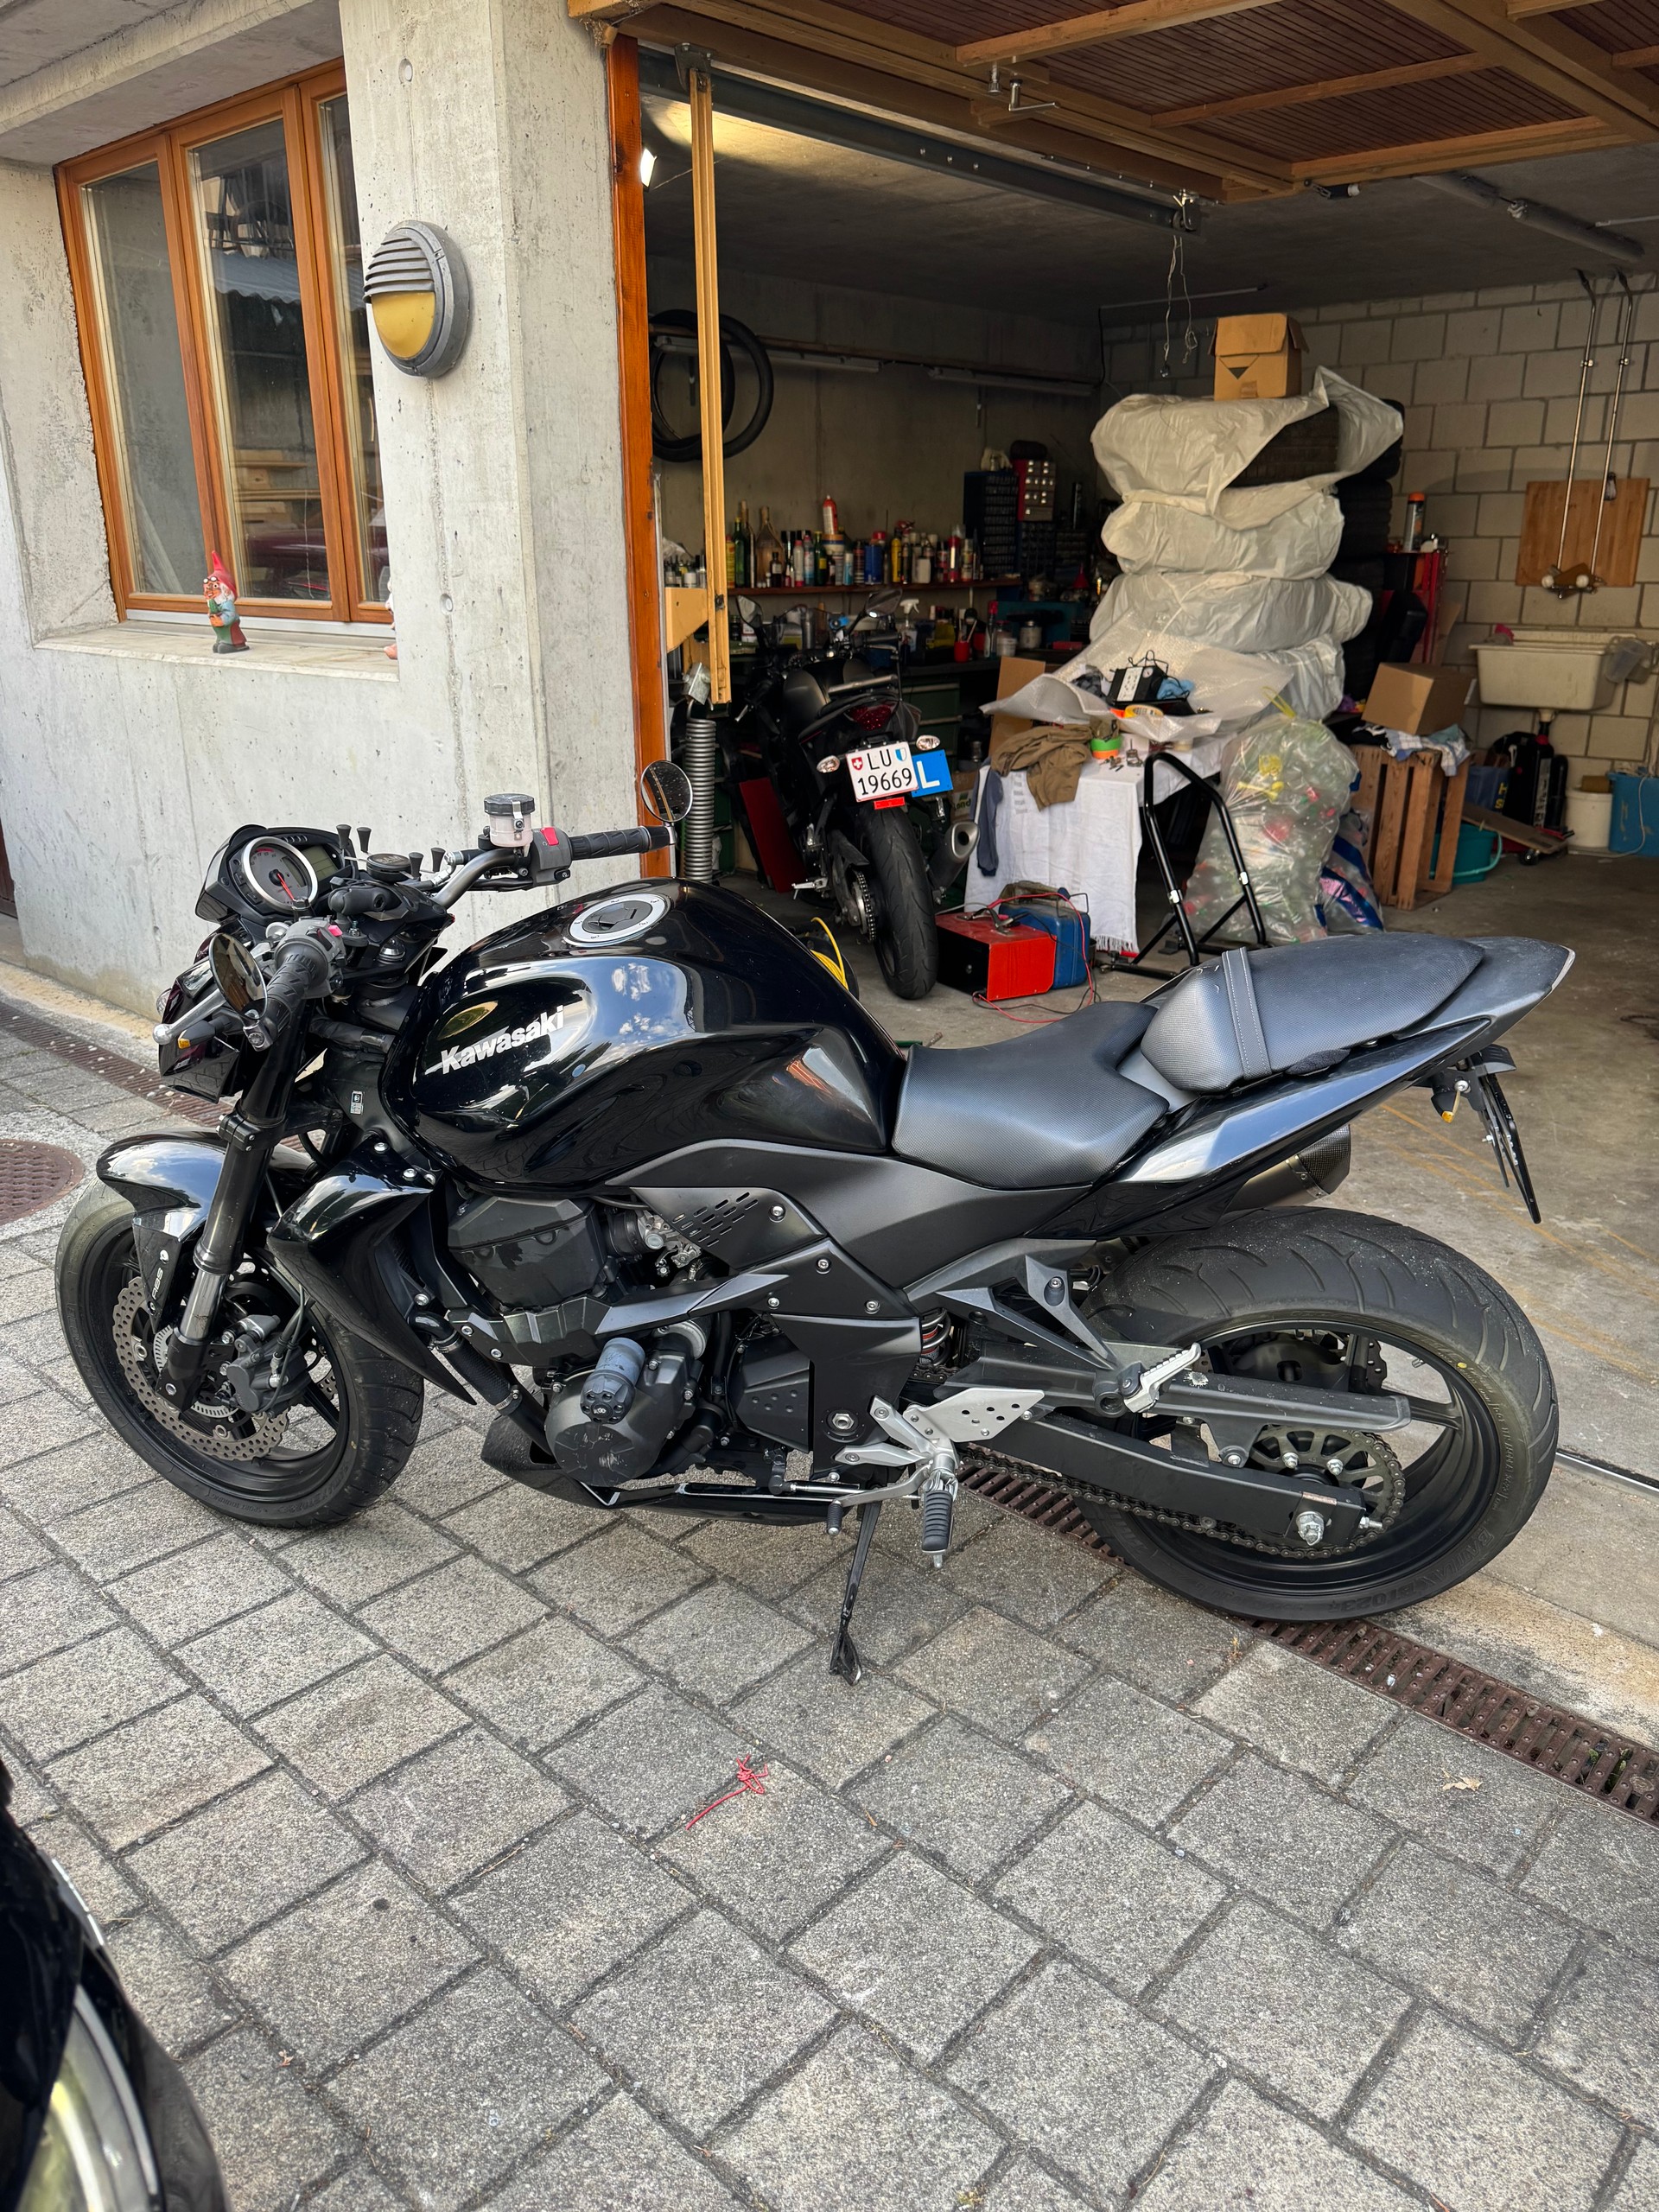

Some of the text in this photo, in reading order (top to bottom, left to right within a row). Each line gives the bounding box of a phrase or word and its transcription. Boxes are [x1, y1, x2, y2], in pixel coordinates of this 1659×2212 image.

[867, 748, 892, 771] LU
[857, 767, 912, 796] 19669
[916, 760, 940, 789] L
[440, 1004, 564, 1075] Kawasaki
[151, 1267, 164, 1300] ABS
